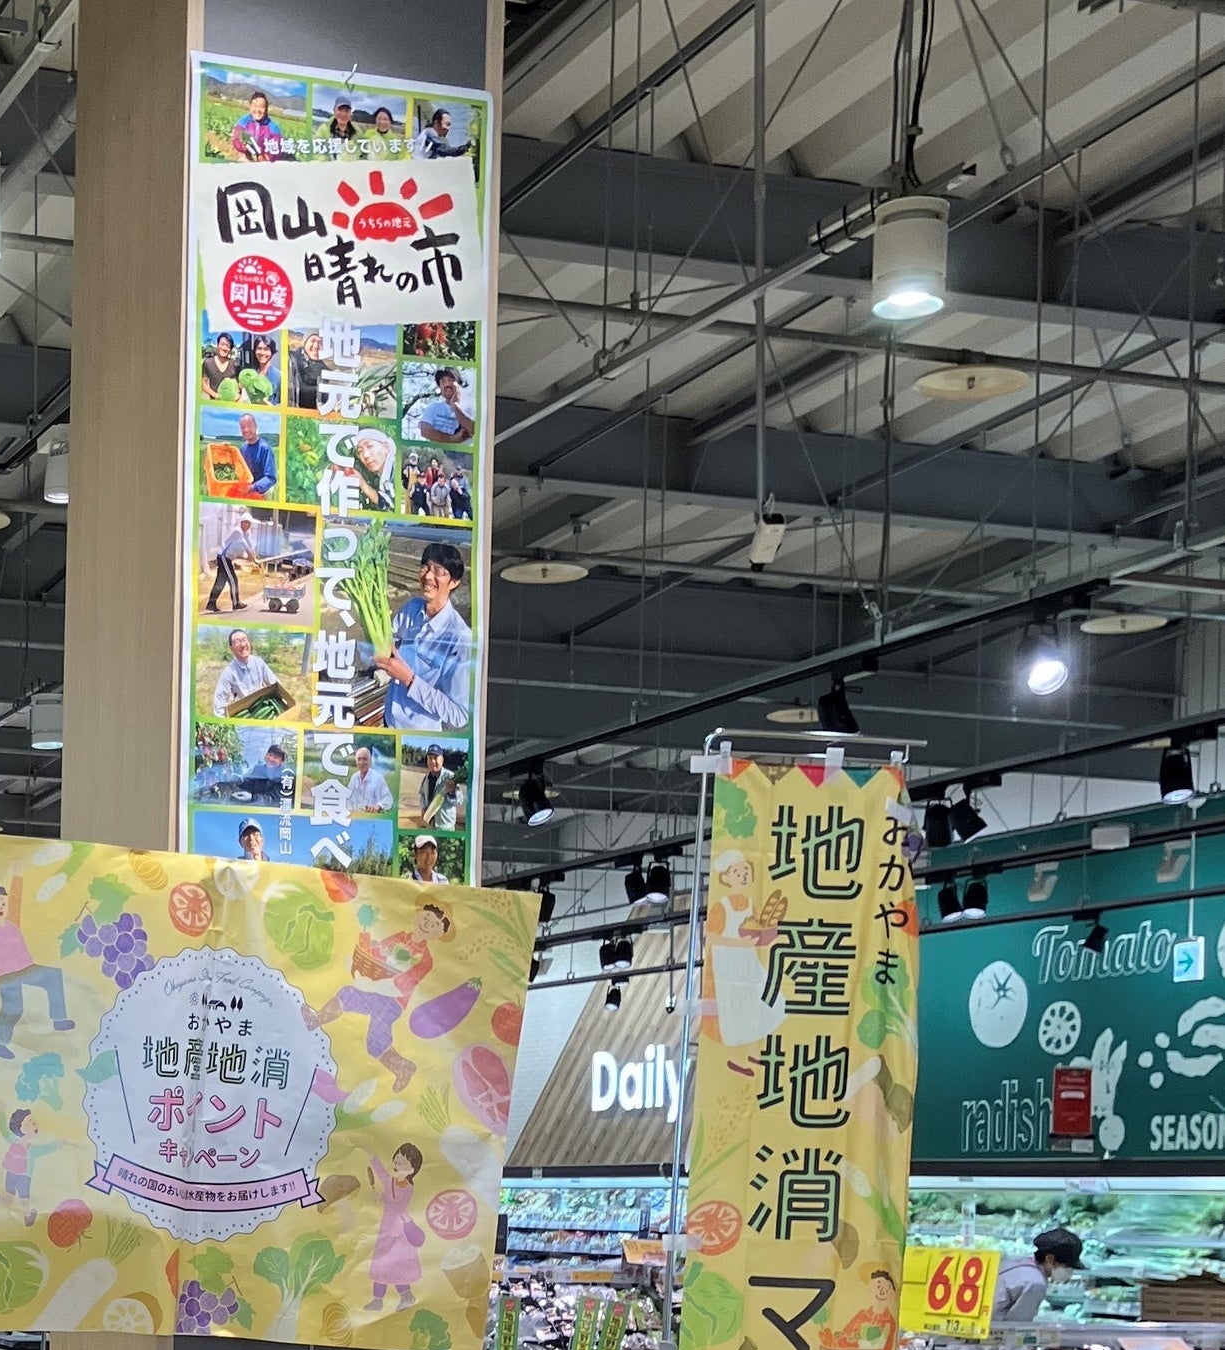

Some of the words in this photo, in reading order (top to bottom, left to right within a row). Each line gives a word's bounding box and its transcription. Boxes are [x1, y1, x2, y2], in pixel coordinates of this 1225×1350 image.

[263, 137, 416, 156] 地域を応援しています
[216, 181, 327, 243] 岡山
[229, 281, 288, 308] 岡山産
[304, 225, 463, 309] 晴れの市
[874, 816, 910, 986] おかやま
[1032, 920, 1175, 985] Tomato
[142, 1036, 291, 1090] 地産地消
[591, 1043, 691, 1123] Daily
[147, 1086, 282, 1139] ポイント
[961, 1077, 1054, 1153] radish
